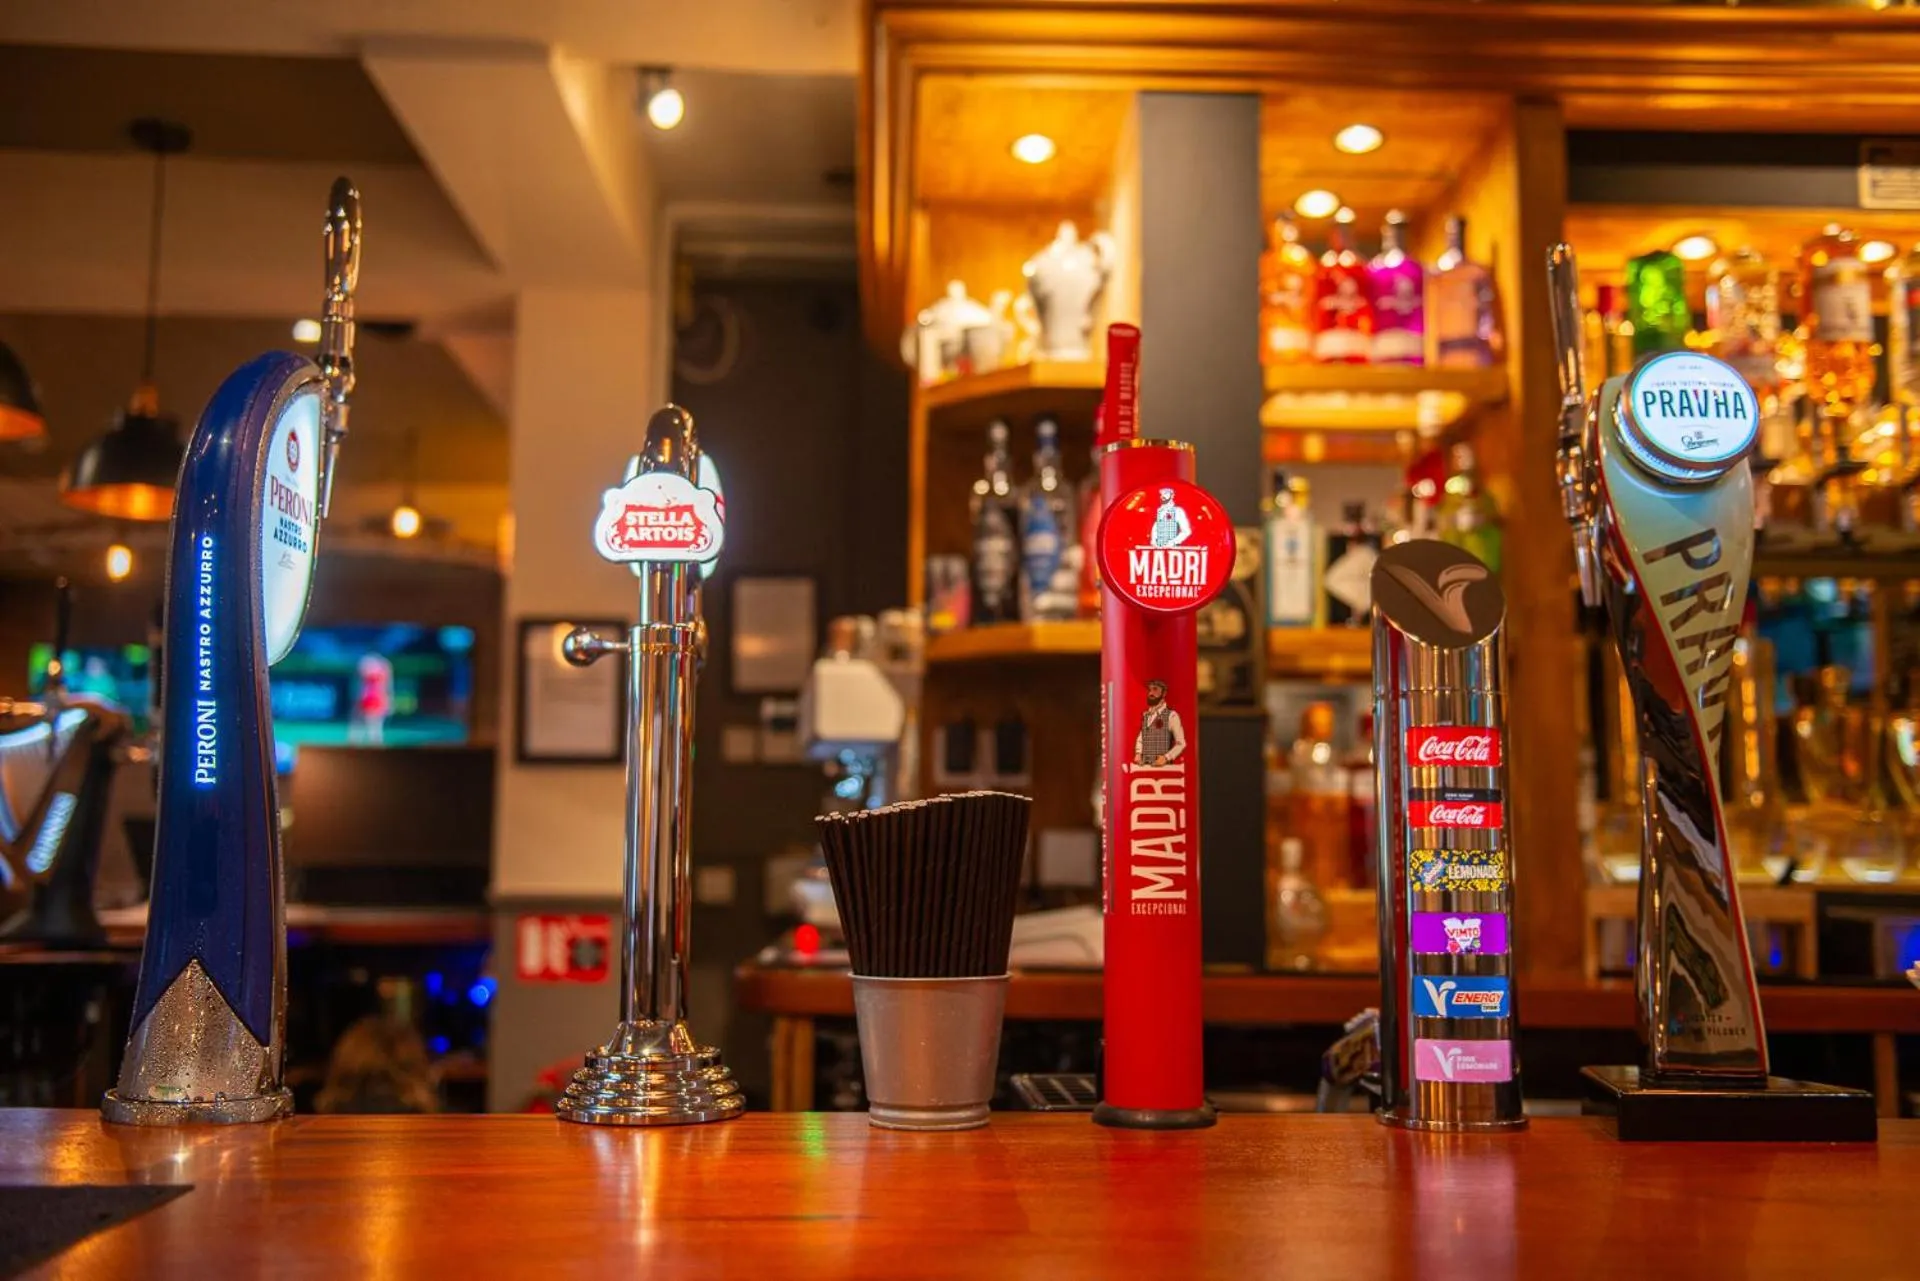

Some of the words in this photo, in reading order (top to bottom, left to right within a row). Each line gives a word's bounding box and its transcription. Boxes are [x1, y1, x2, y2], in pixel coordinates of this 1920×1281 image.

[1642, 388, 1748, 420] PRAVHA
[270, 473, 313, 527] PERONI
[279, 516, 302, 537] NASTRO
[625, 511, 694, 526] STELLA
[273, 526, 308, 554] AZZURRO
[624, 526, 696, 541] ARTOIS
[1128, 546, 1209, 585] MADRÍ
[200, 535, 214, 620] AZZURRO
[199, 623, 213, 691] NASTRO
[195, 700, 217, 785] PERONI
[1418, 735, 1492, 761] Coca-Cola
[1429, 804, 1487, 825] Coca-Cola
[1448, 864, 1499, 879] LEMONADE
[1130, 902, 1188, 915] EXCEPCIONAL
[1447, 927, 1480, 938] VIMTO
[1455, 992, 1502, 1003] ENERGY
